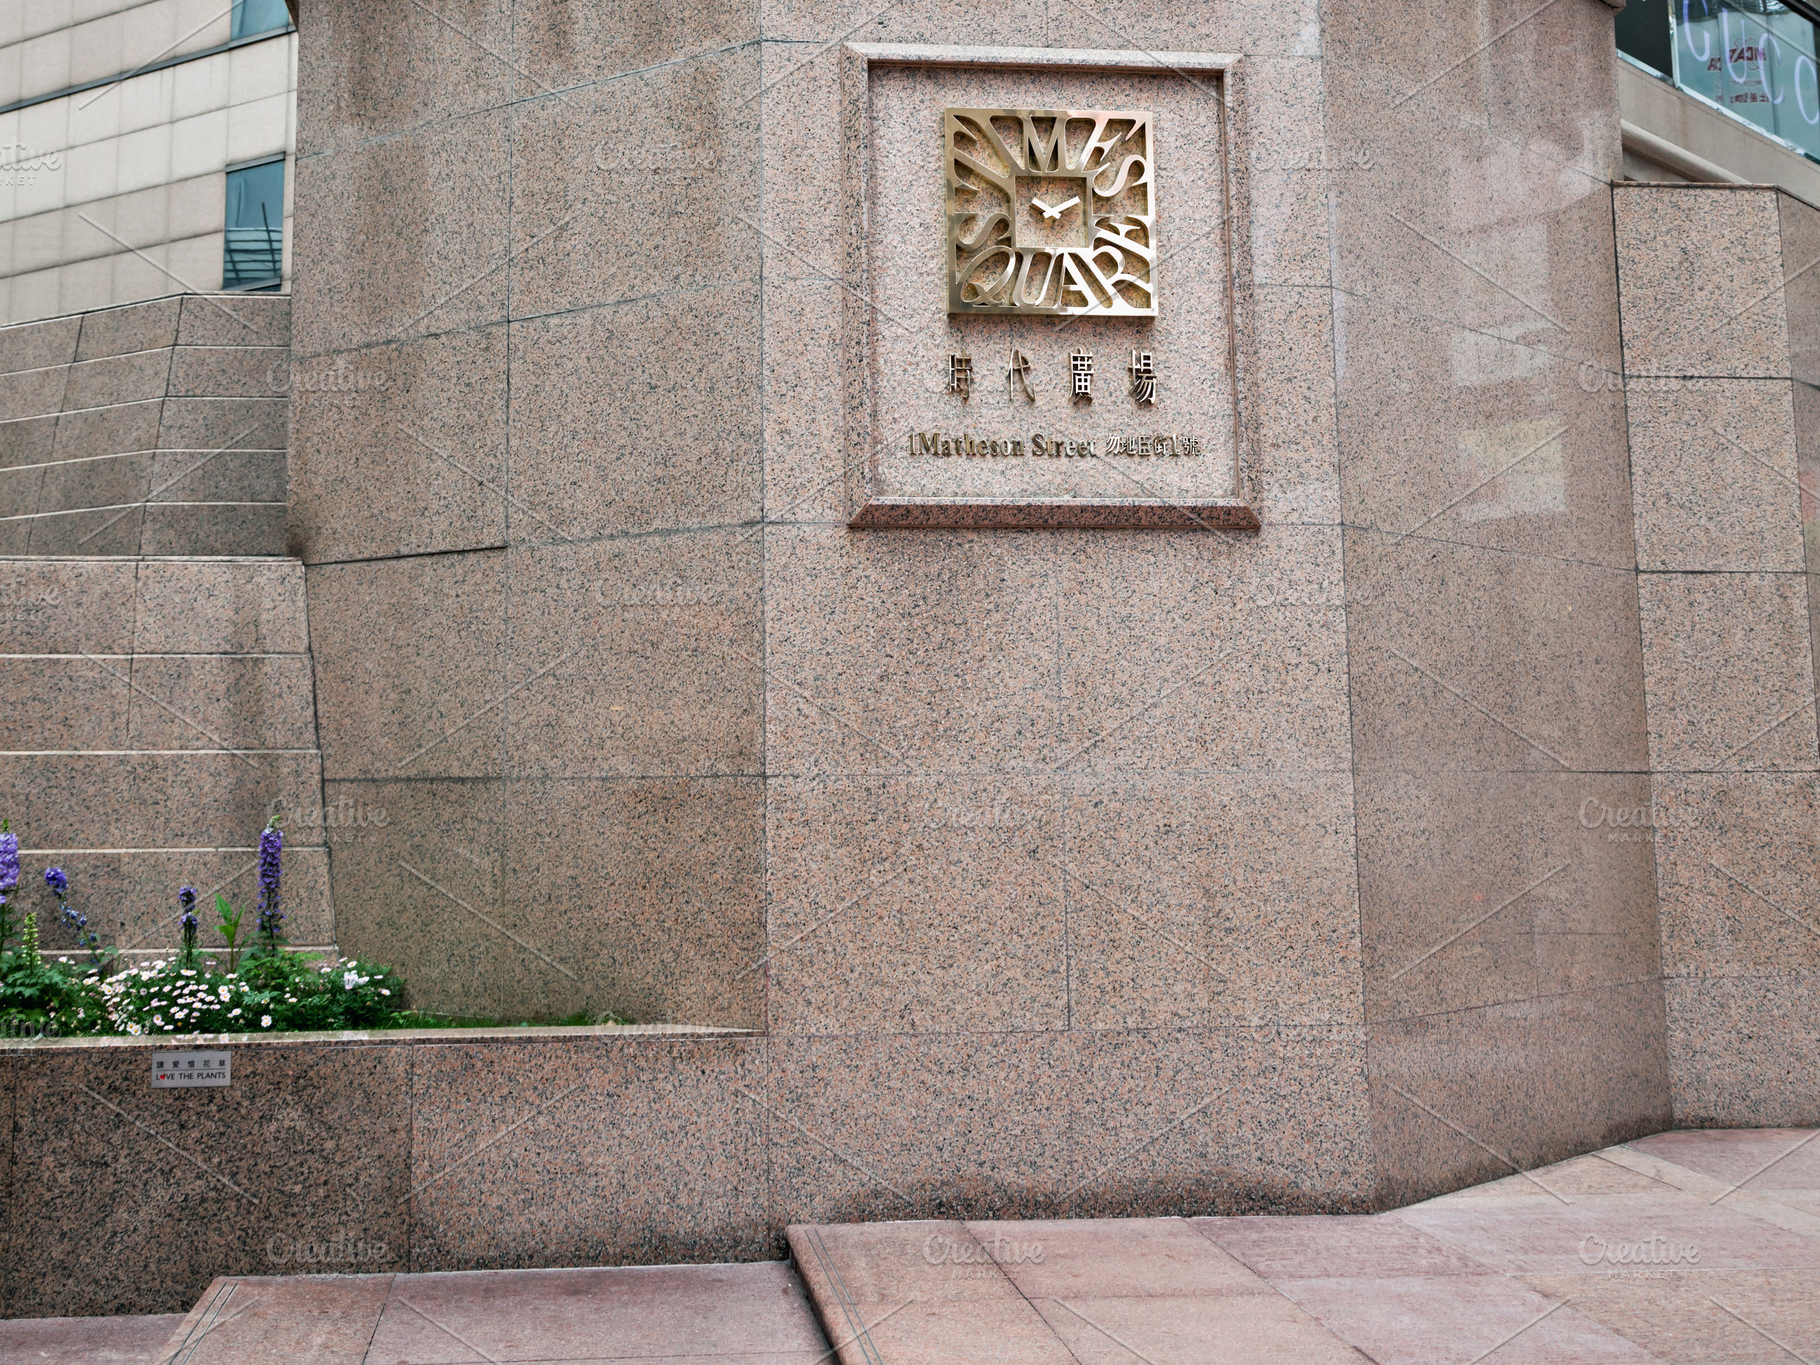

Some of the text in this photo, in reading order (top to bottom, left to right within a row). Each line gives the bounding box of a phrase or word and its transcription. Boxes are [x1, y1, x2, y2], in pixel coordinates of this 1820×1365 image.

[948, 347, 1158, 407] 時代廣場
[1031, 432, 1098, 458] Street
[179, 1072, 194, 1080] THE
[196, 1071, 226, 1080] PLANTS
